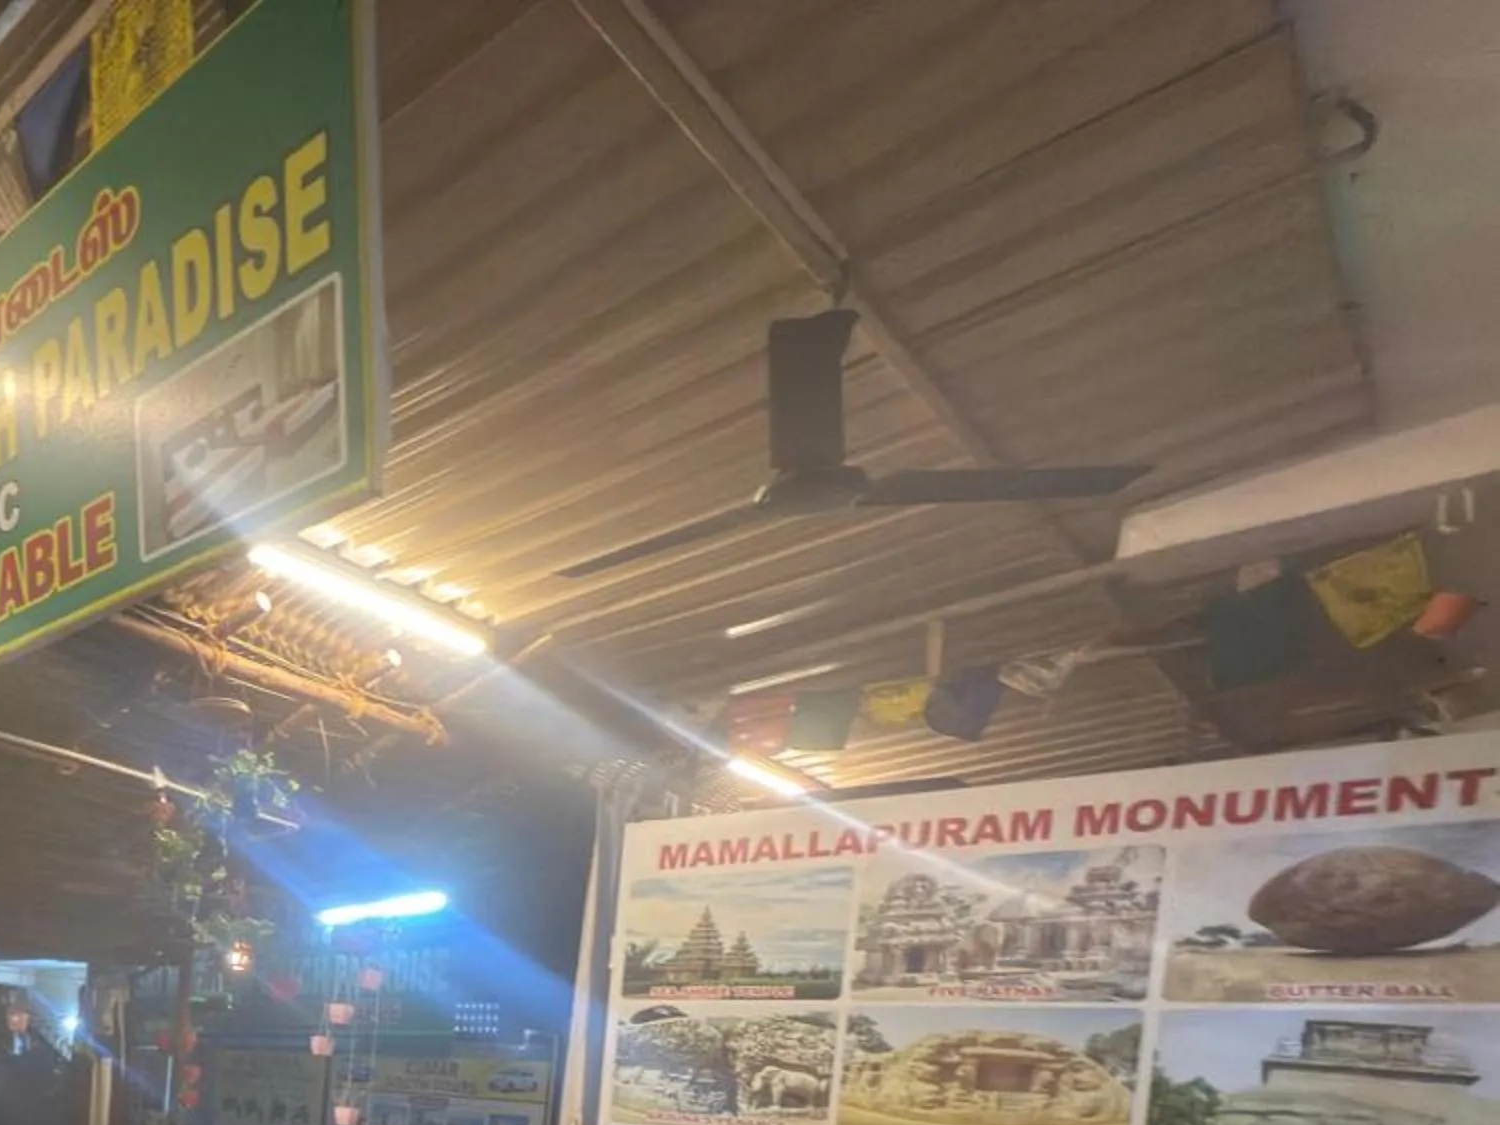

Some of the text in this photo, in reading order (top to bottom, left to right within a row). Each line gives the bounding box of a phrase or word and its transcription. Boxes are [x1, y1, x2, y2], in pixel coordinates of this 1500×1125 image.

[33, 130, 331, 438] PARADISE
[657, 767, 1500, 871] MAMALLAPURAM MONUMENT
